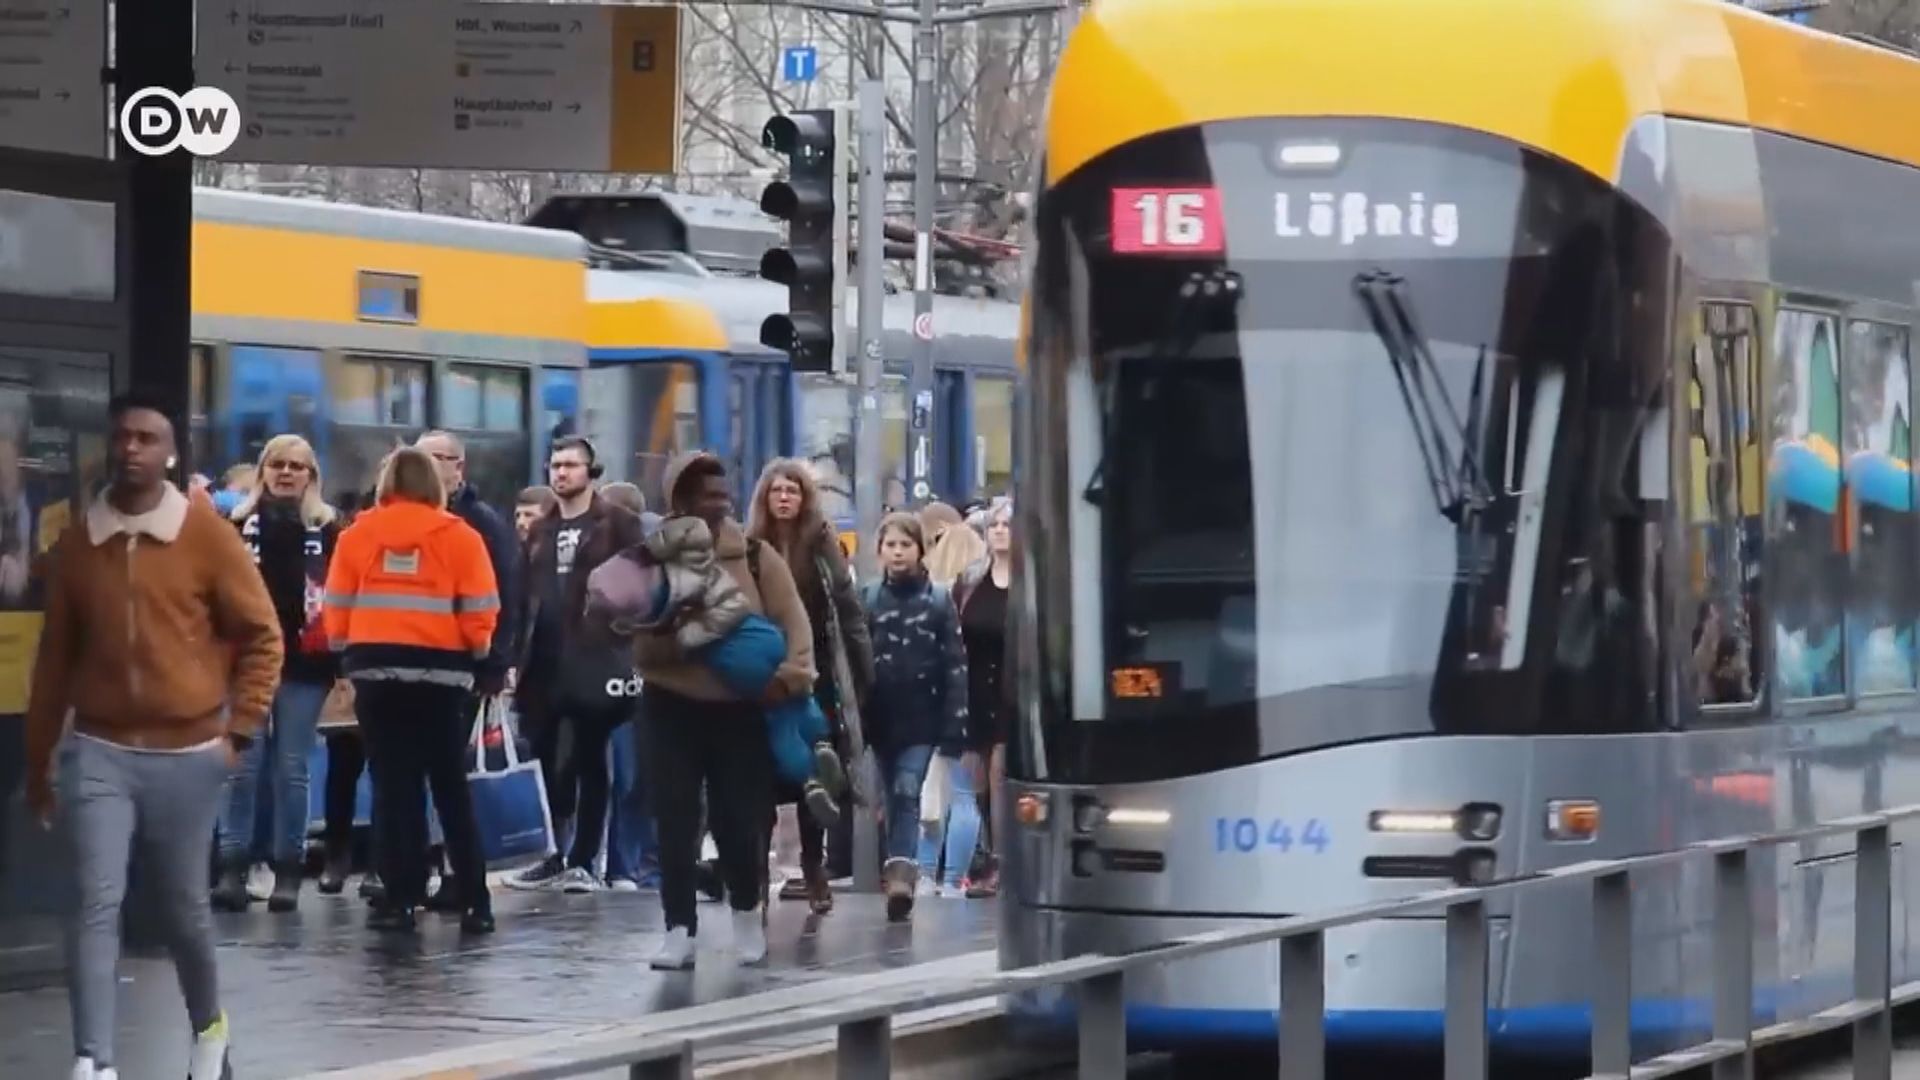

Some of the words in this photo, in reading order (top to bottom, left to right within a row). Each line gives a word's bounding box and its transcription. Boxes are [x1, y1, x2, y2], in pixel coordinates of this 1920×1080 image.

[791, 52, 808, 78] T
[1133, 193, 1204, 246] 16
[1274, 191, 1459, 247] Lößnig
[1215, 817, 1331, 853] 1044
